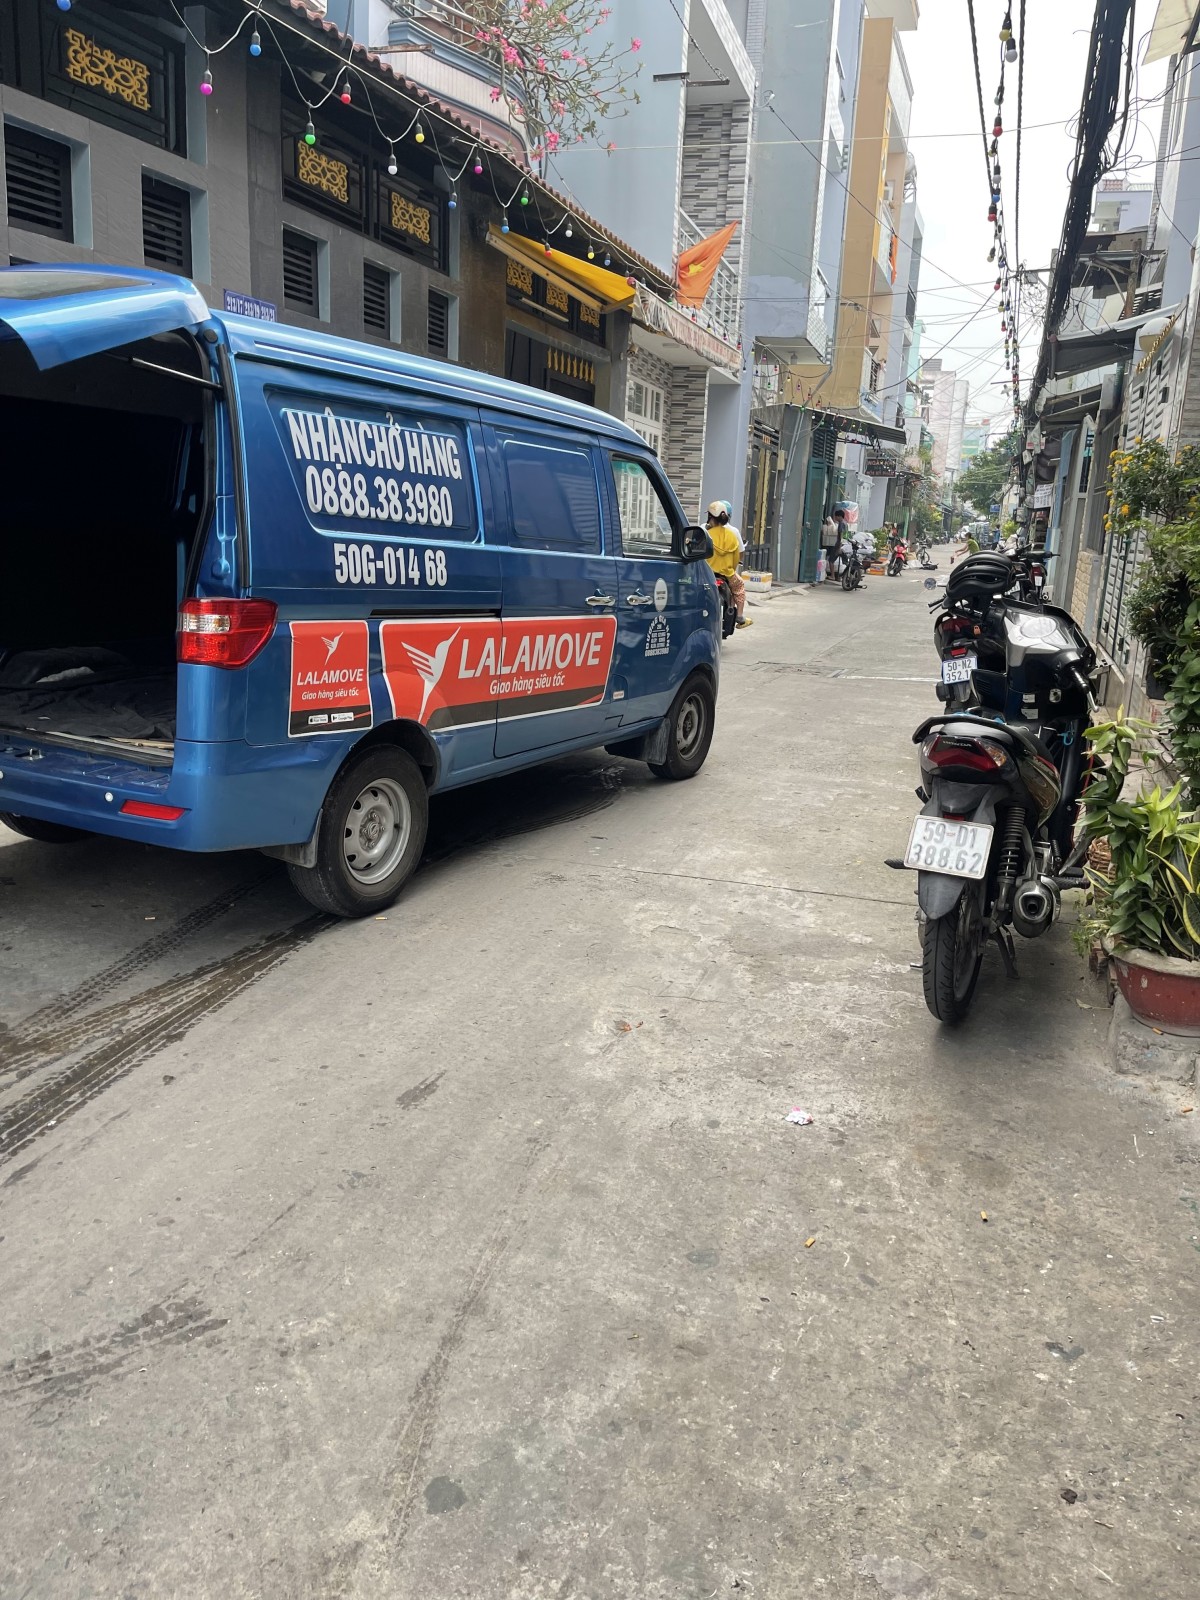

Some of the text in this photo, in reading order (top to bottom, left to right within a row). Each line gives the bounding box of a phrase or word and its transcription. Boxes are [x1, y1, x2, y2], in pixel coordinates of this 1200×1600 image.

[405, 422, 462, 480] HÀNG
[458, 632, 604, 679] LALAMOVE
[948, 659, 972, 672] 50-N2
[296, 668, 363, 686] LALAMOVE
[490, 670, 565, 694] Giao hàng siêu tốc
[946, 670, 973, 682] 352.1
[302, 687, 359, 701] Giao hàng siêu tốc
[923, 821, 978, 848] 59-D1
[910, 844, 982, 874] 388.62
